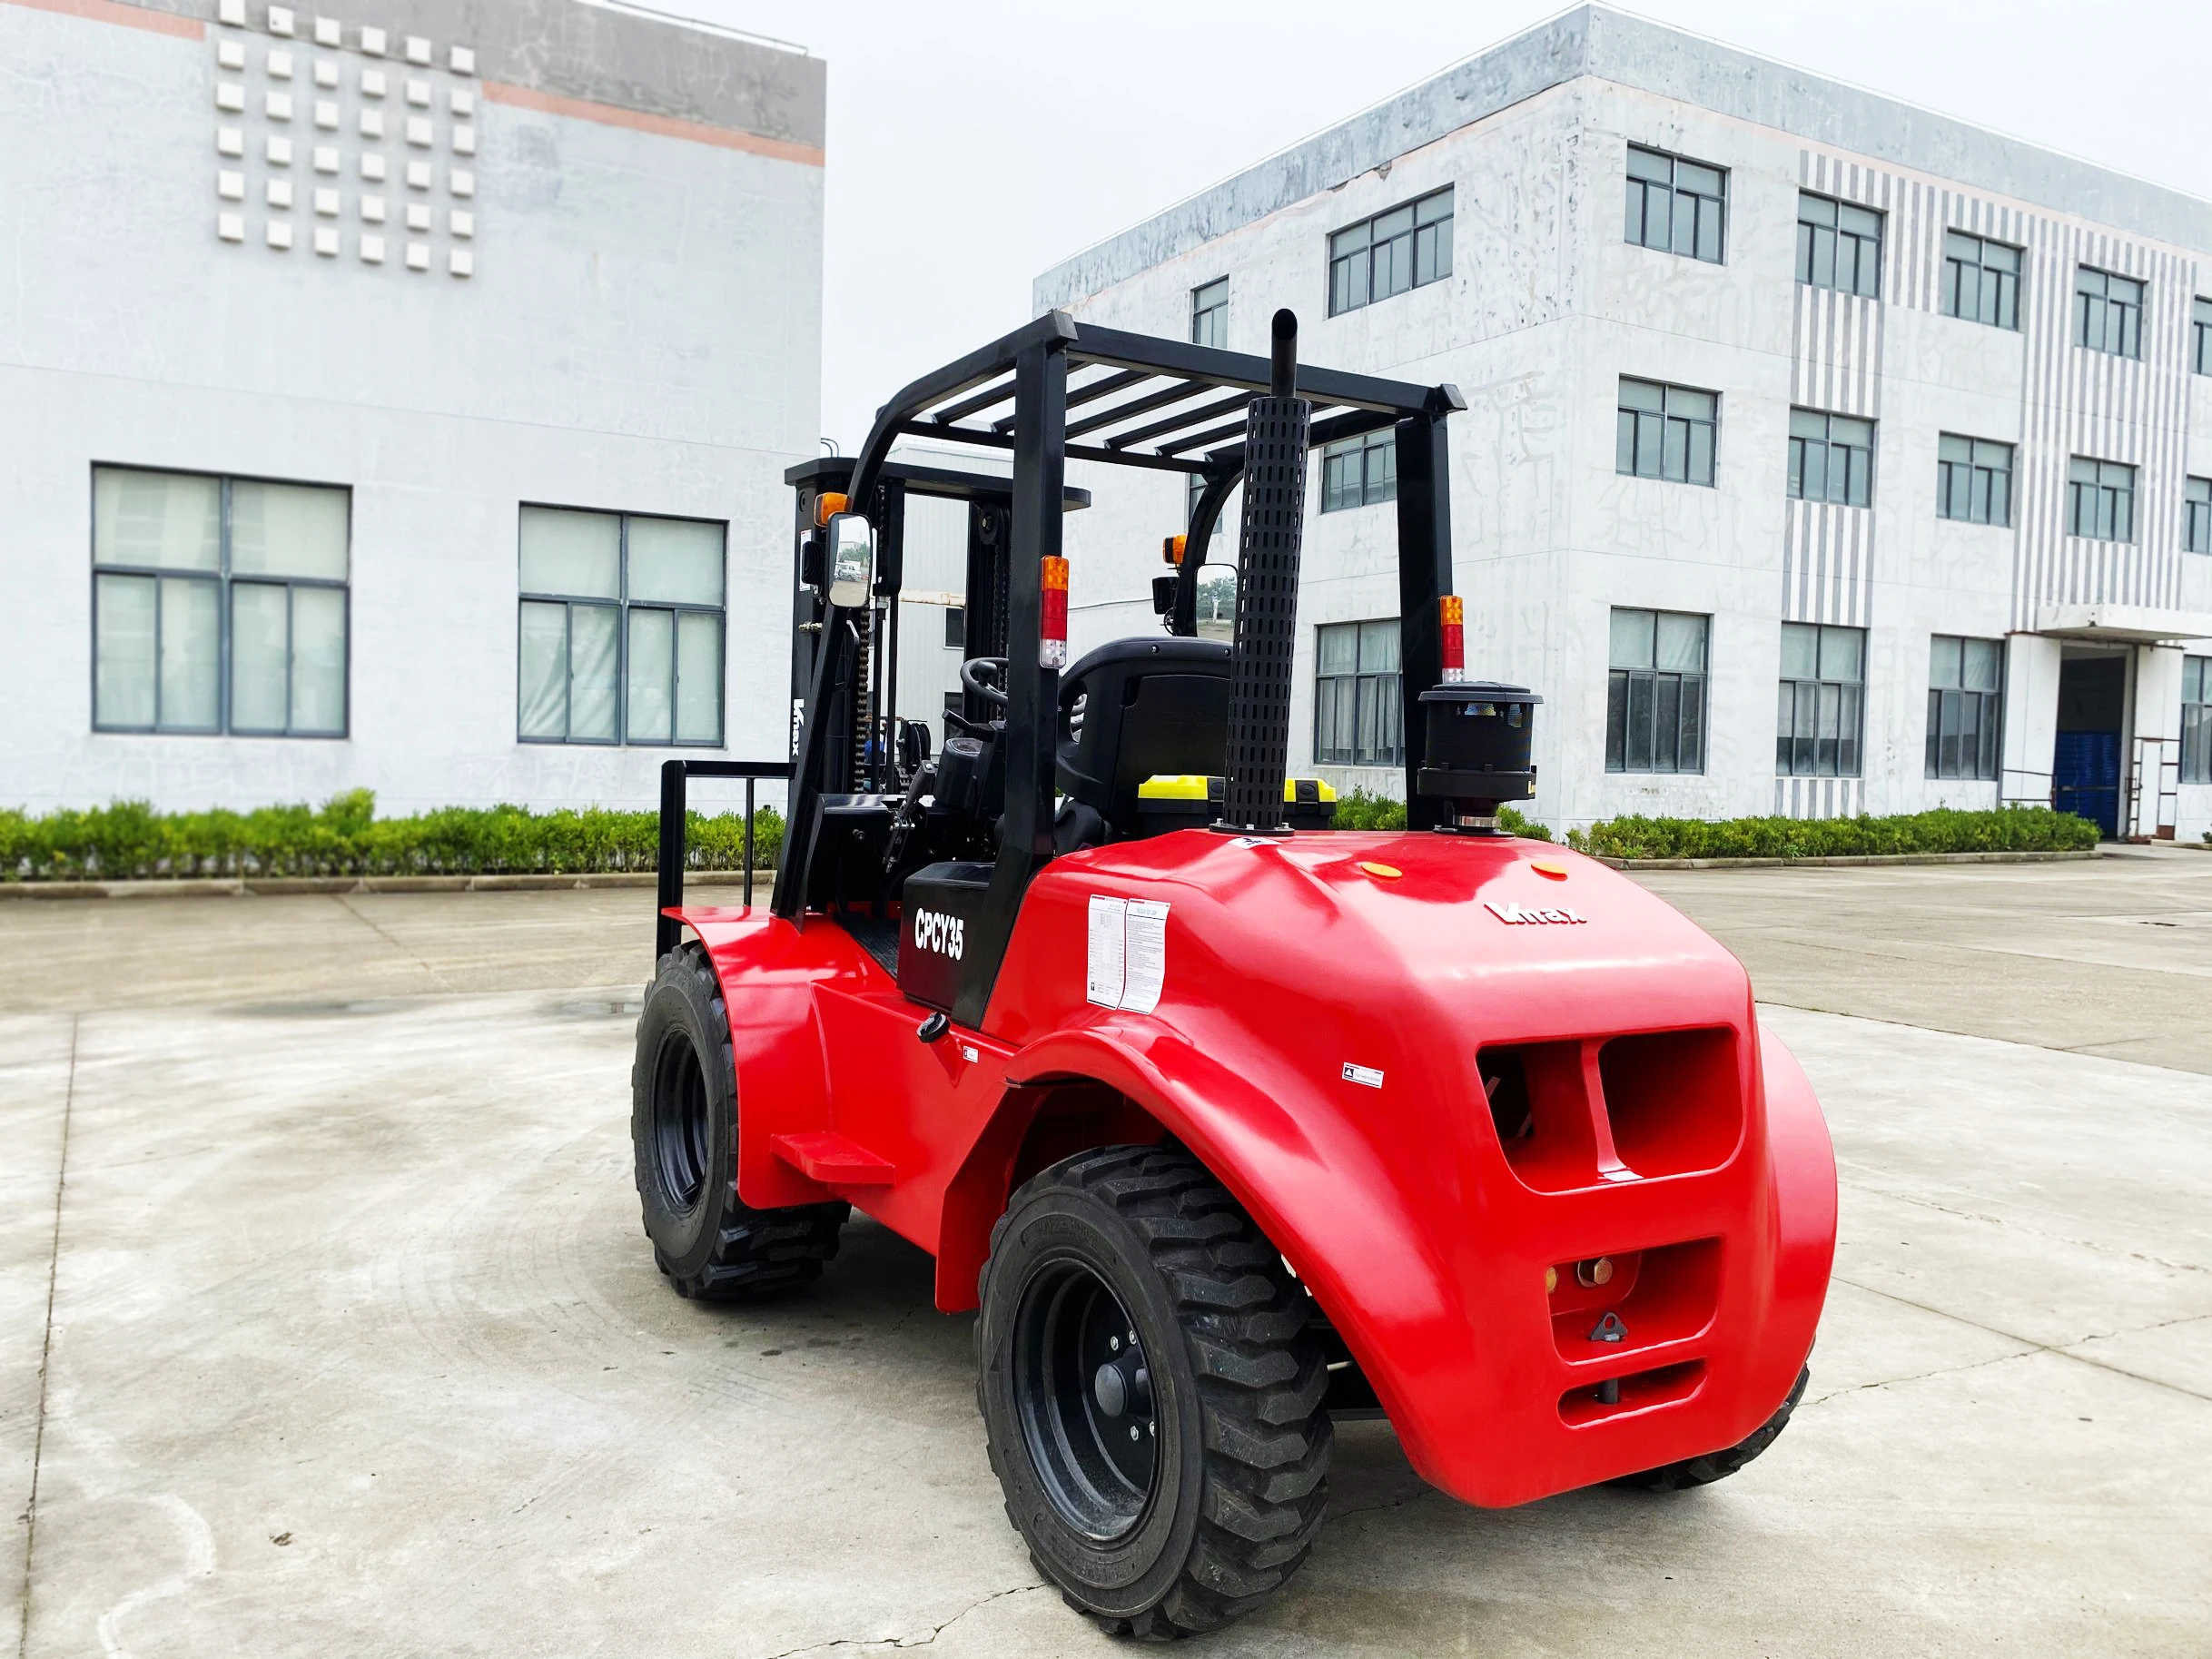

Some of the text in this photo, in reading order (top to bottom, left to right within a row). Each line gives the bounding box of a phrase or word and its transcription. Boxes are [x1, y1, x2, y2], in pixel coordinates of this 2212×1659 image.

[793, 699, 804, 755] Vmax
[915, 908, 963, 960] CPCY35
[1484, 903, 1587, 924] Vmax
